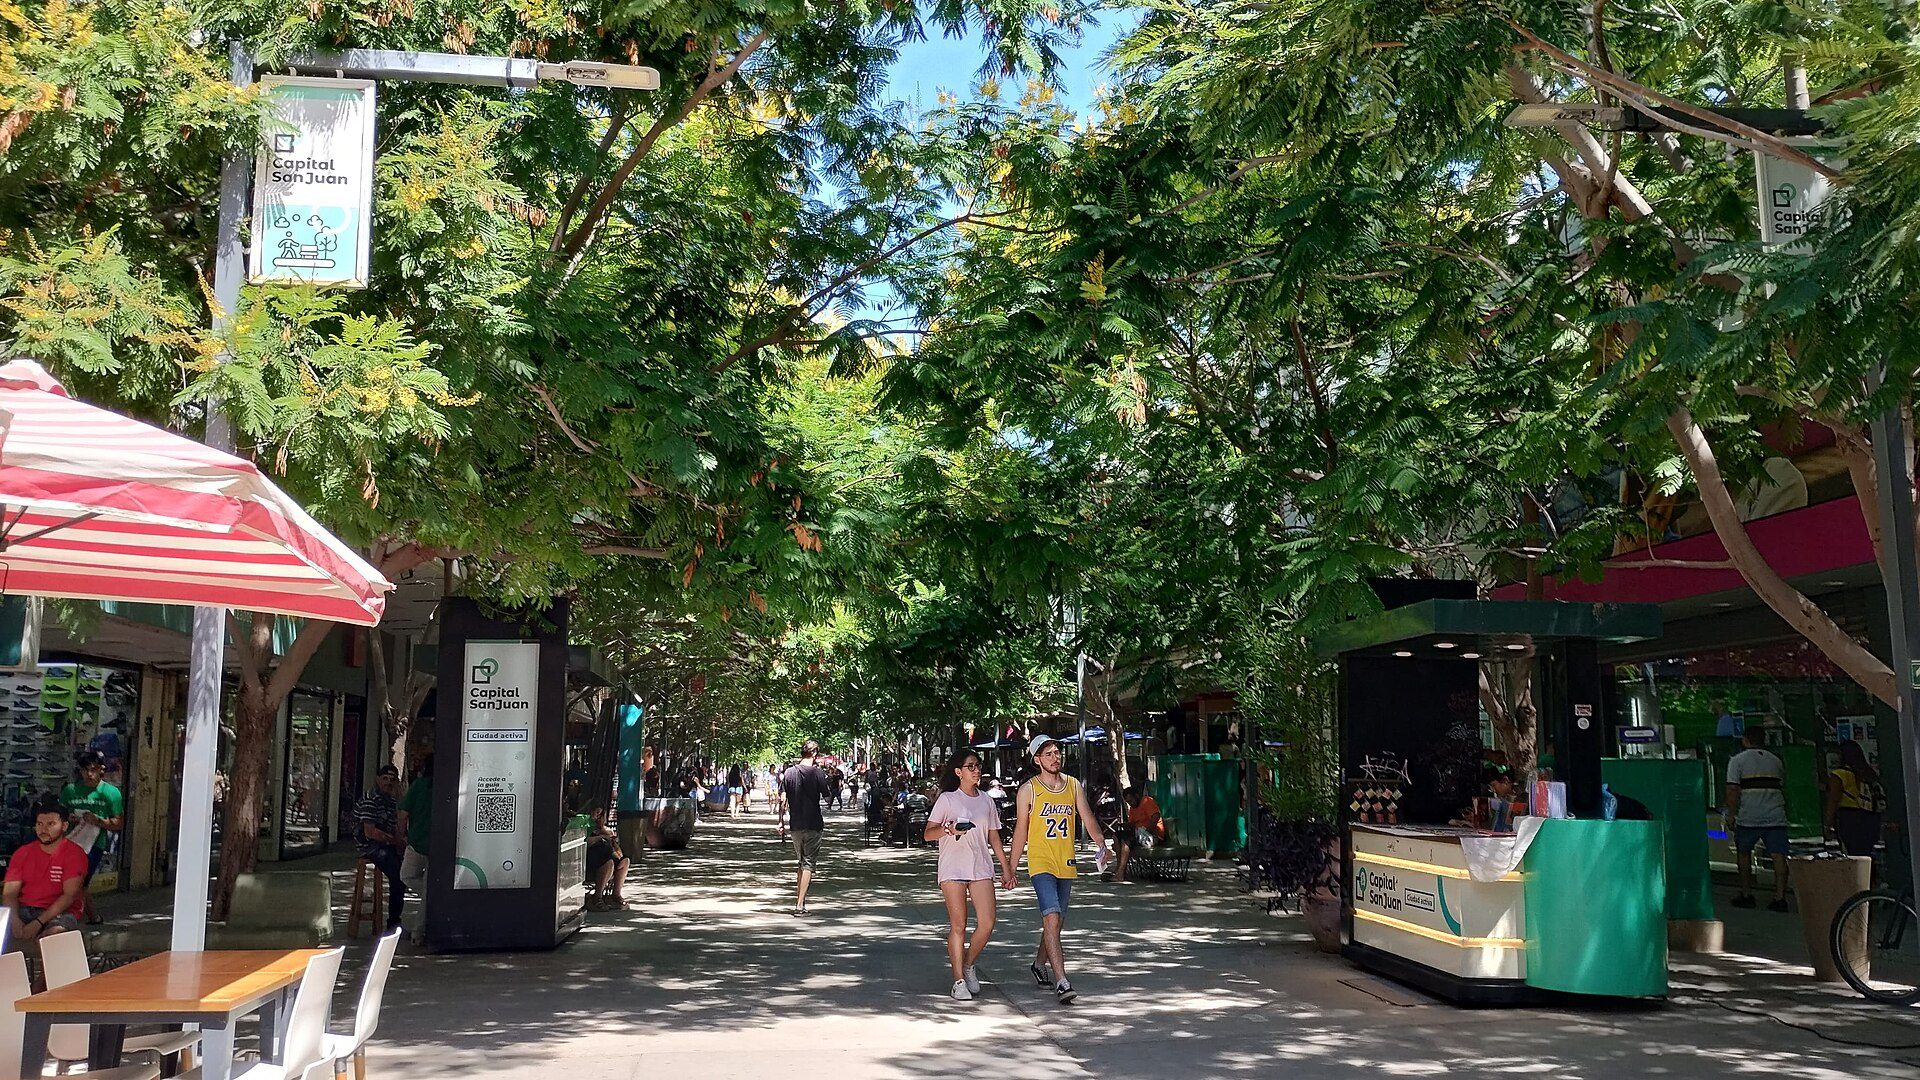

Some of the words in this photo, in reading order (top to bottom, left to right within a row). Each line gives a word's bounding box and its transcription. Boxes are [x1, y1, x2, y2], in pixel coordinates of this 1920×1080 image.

[272, 157, 335, 172] Capital
[470, 687, 519, 699] Capital
[1046, 818, 1068, 838] 24
[1369, 871, 1396, 891] Capital
